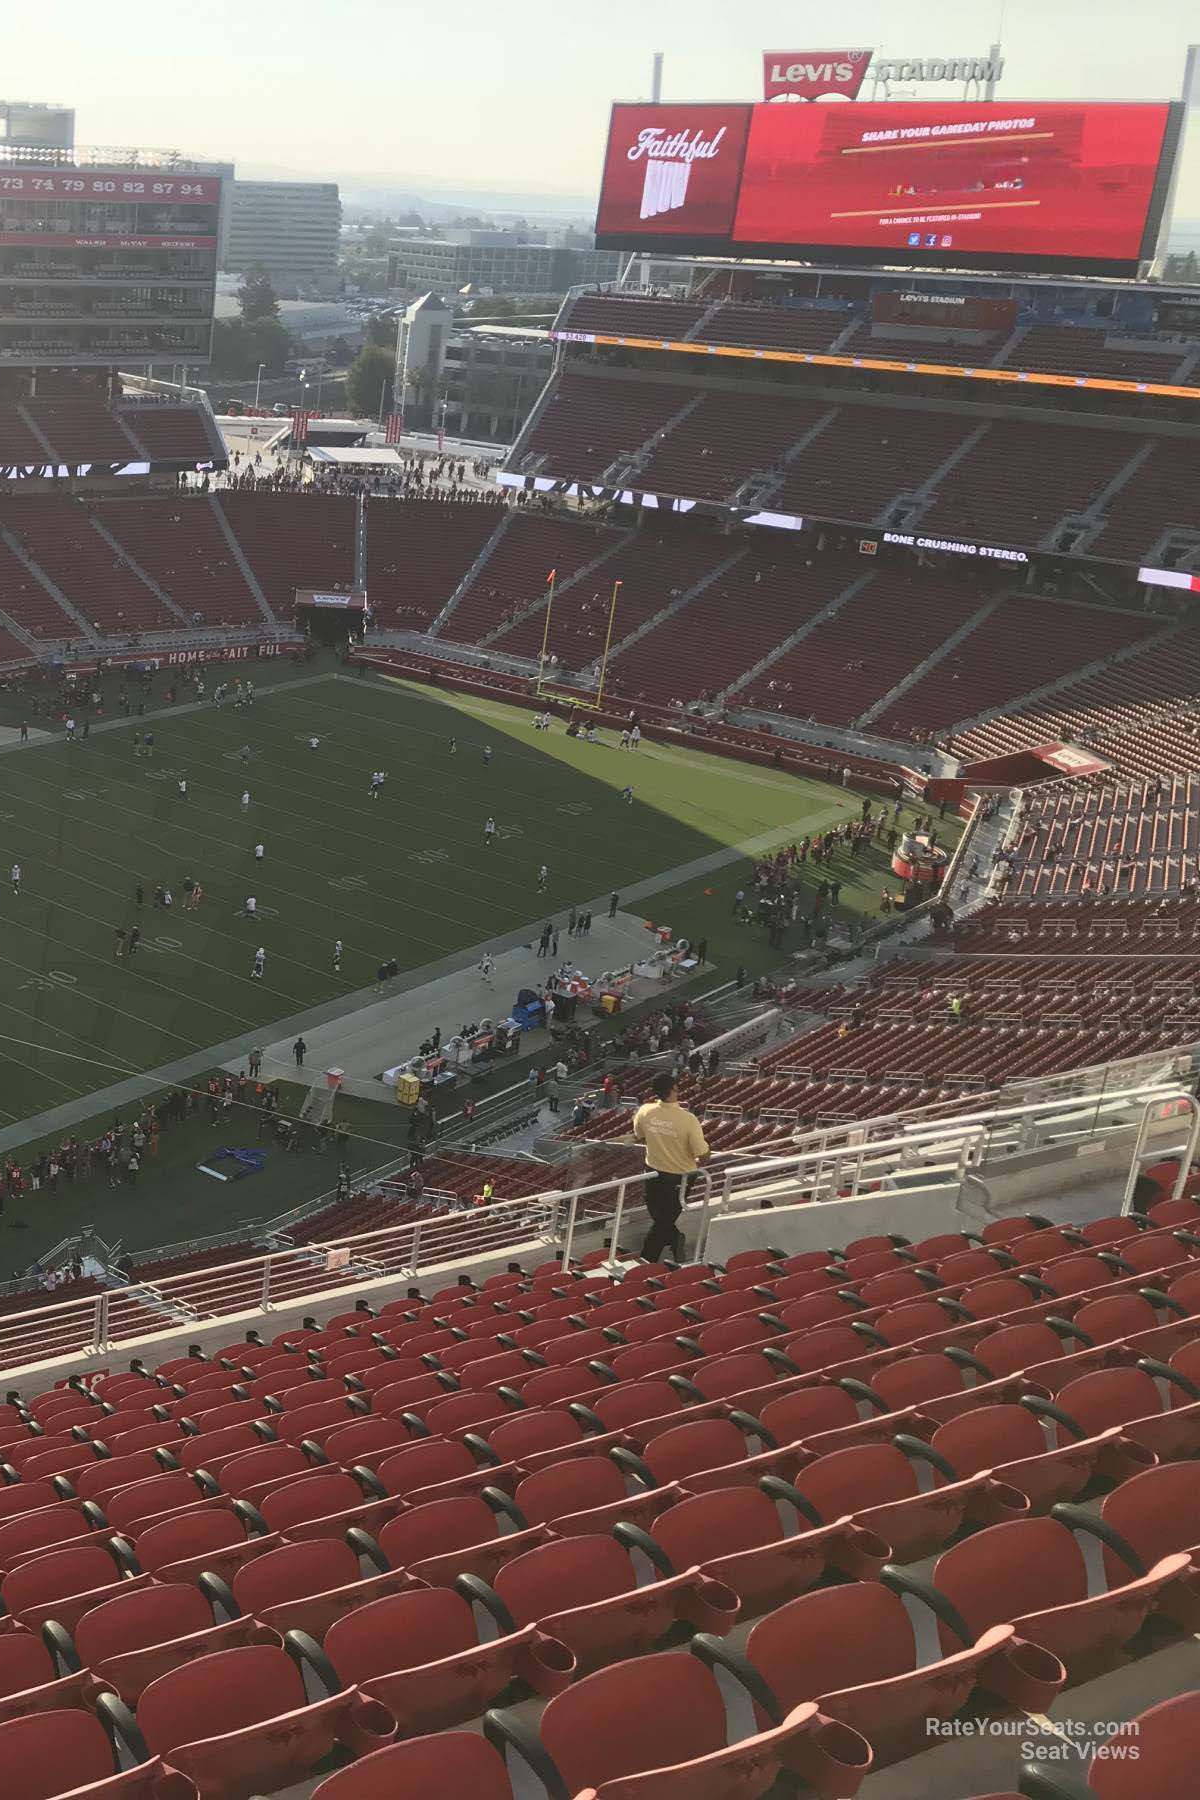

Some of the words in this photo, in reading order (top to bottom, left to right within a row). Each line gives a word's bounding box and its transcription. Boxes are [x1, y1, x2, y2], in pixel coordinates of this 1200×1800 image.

[873, 57, 1005, 82] STADIUM
[862, 130, 899, 142] SHARE
[900, 126, 930, 139] YOUR
[931, 121, 988, 136] GAMEDAY
[987, 118, 1036, 131] PHOTOS
[627, 126, 727, 163] Faithful
[883, 533, 915, 546] BONE
[916, 537, 976, 554] CRUSHING
[169, 650, 205, 664] HOME
[223, 645, 282, 659] FAITFUL
